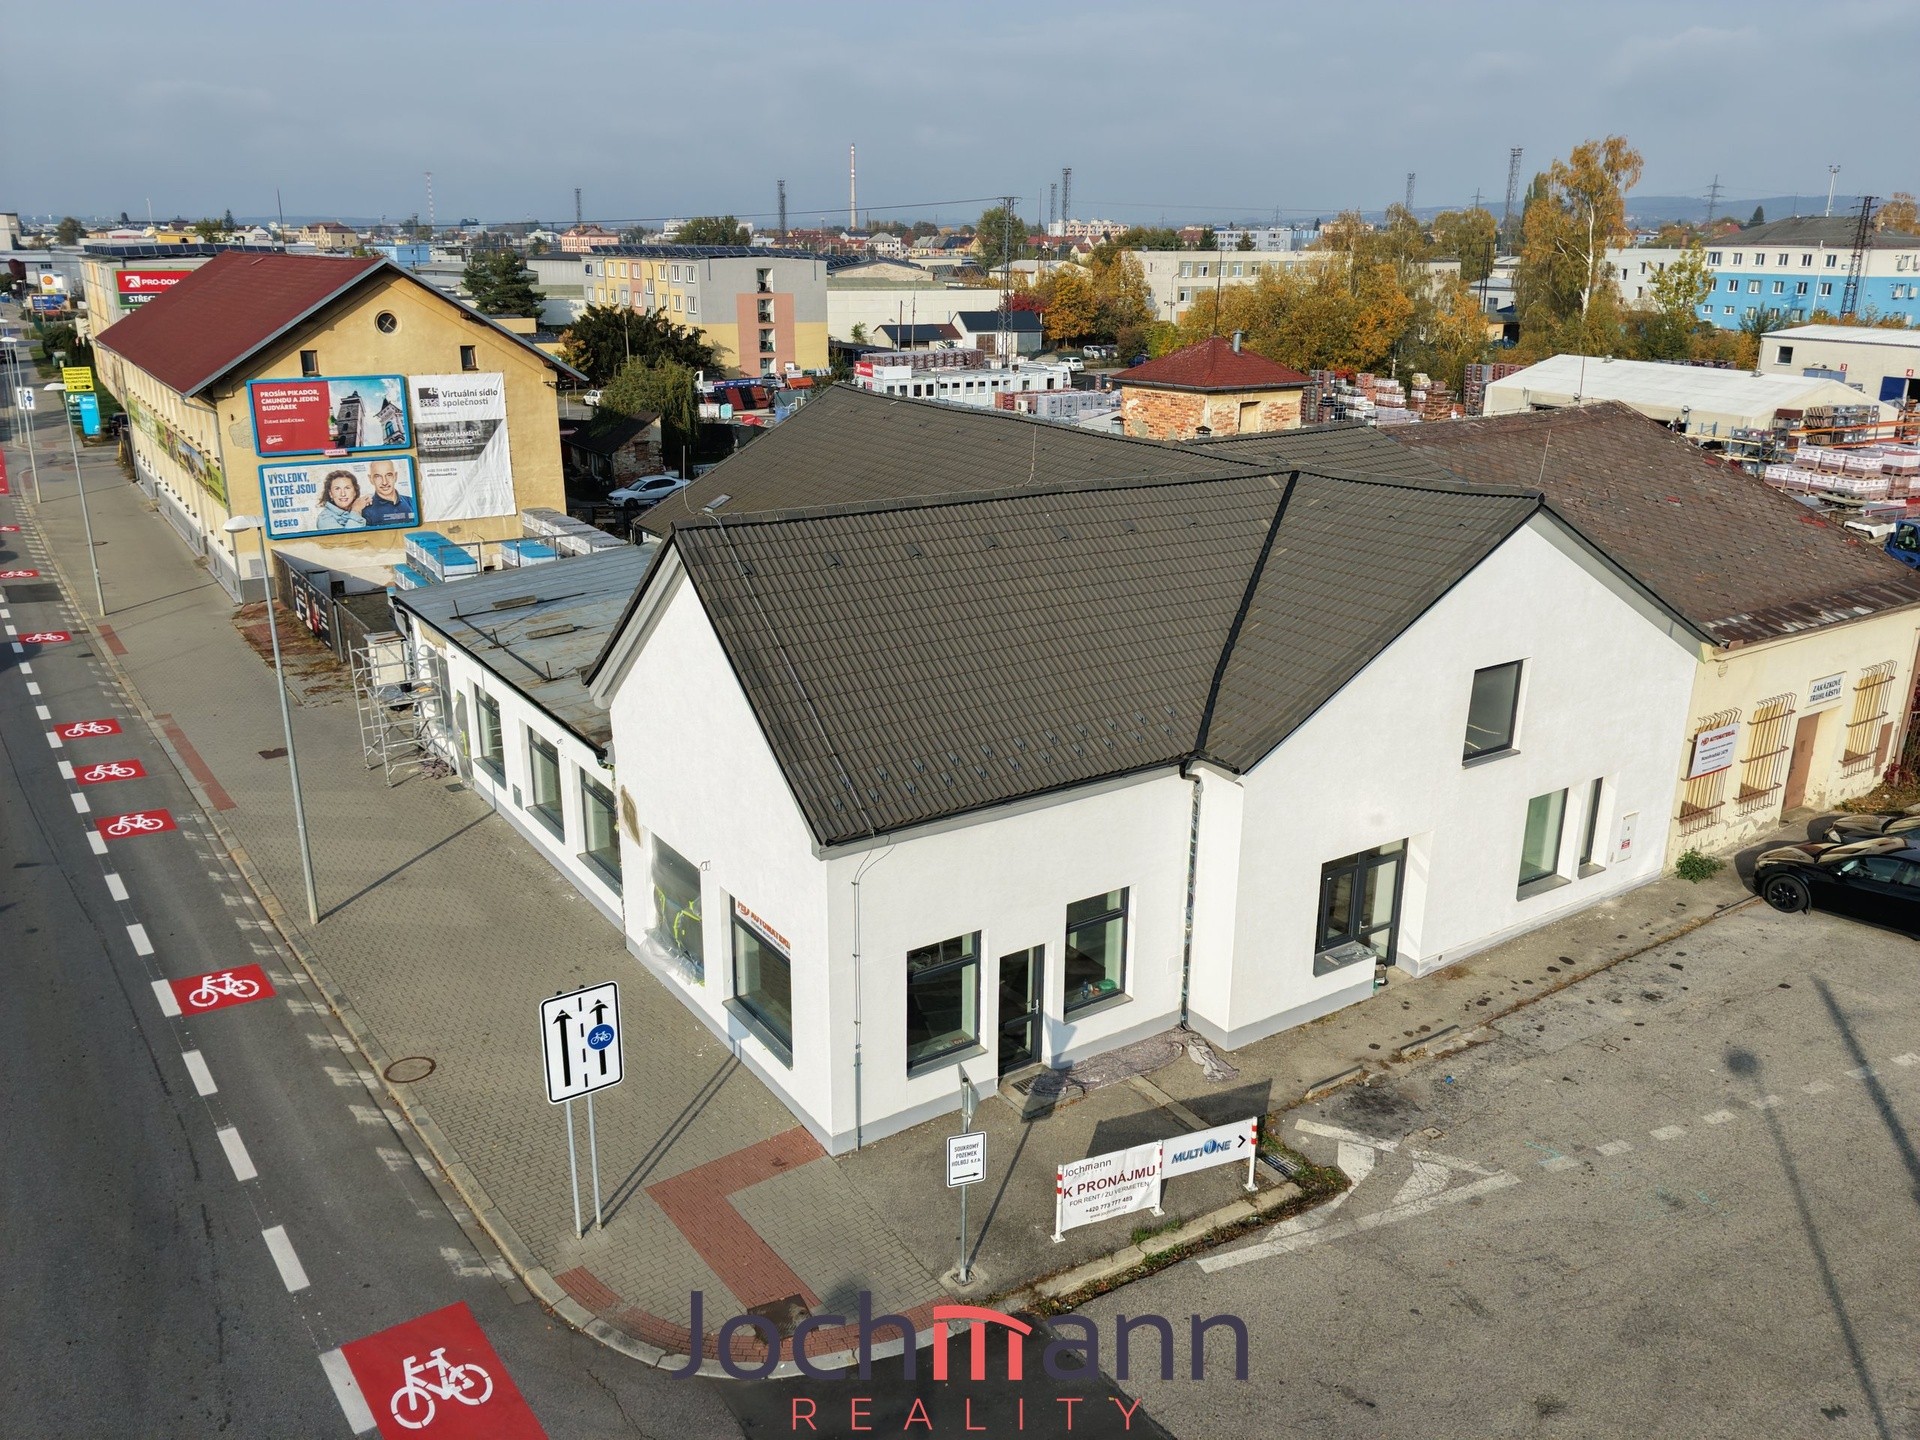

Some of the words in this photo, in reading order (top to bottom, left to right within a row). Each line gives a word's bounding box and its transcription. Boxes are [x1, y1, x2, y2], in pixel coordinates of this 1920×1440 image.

[128, 294, 155, 303] STŘEC
[260, 389, 287, 398] PROSÍM
[441, 388, 477, 398] Virtuální
[479, 388, 498, 396] sídlo
[269, 483, 294, 496] KTERÉ
[296, 484, 316, 494] JSOU
[271, 496, 293, 508] VIDĚT
[954, 1142, 980, 1152] SOUKROMÝ
[955, 1150, 978, 1159] POZEMEK
[1064, 1160, 1112, 1178] Jochmann
[1063, 1187, 1073, 1199] K
[1077, 1165, 1156, 1195] PRONÁJMU
[1069, 1198, 1083, 1207] FOR
[1083, 1194, 1101, 1203] RENT
[1104, 1190, 1114, 1198] ZU
[1114, 1182, 1150, 1195] VERMIETEN
[1085, 1205, 1099, 1213] +420
[1100, 1202, 1111, 1210] 773
